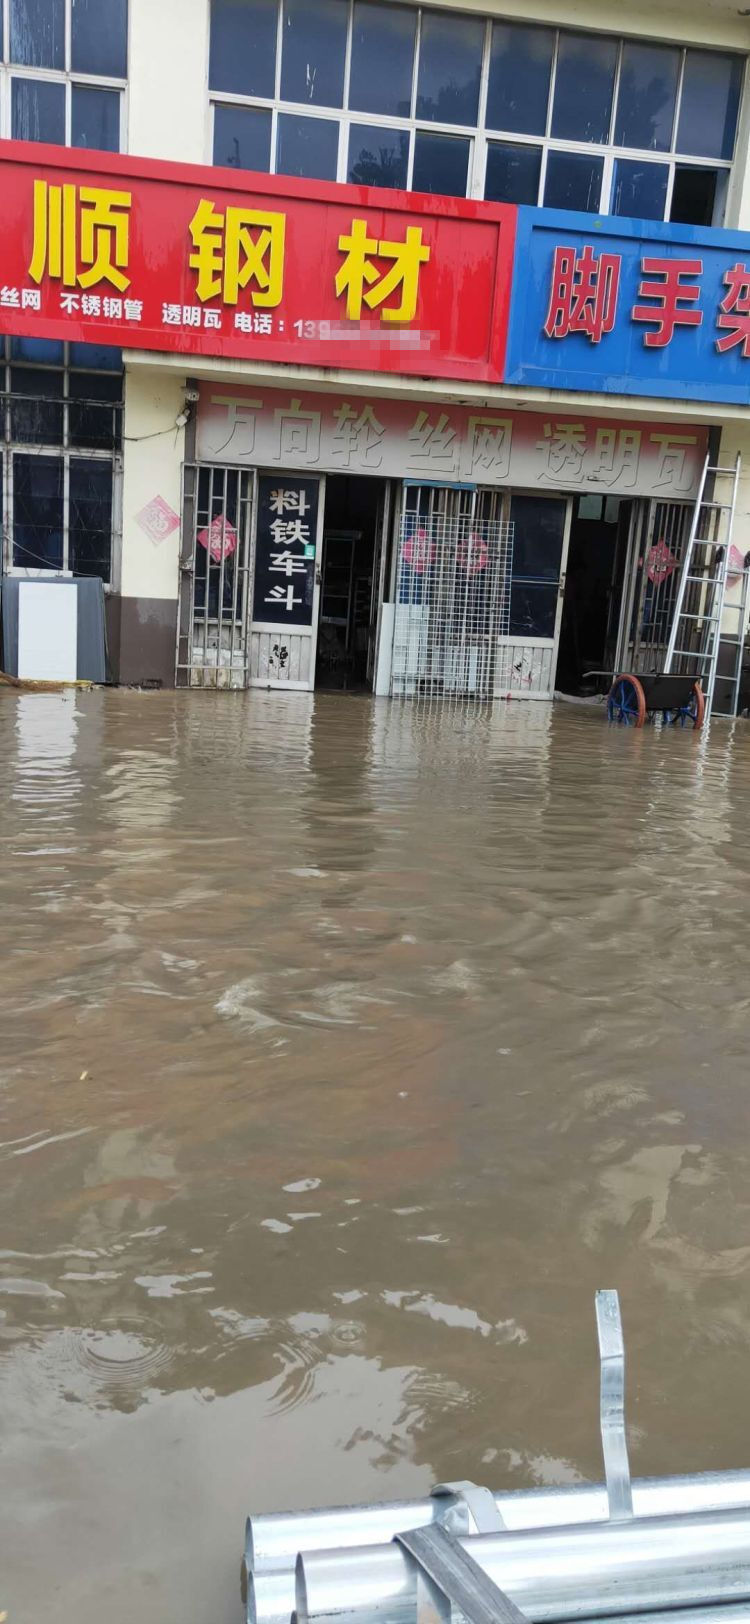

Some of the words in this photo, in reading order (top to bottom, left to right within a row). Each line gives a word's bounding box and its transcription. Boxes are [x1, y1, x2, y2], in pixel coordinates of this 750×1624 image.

[28, 179, 431, 324] 顺钢材
[0, 286, 41, 310] 丝网
[60, 292, 143, 321] 不锈钢管
[162, 303, 222, 328] 透明瓦
[208, 395, 386, 468] 万向轮
[406, 410, 513, 479] 丝网
[536, 422, 697, 491] 透明瓦
[264, 488, 314, 611] 料铁车斗
